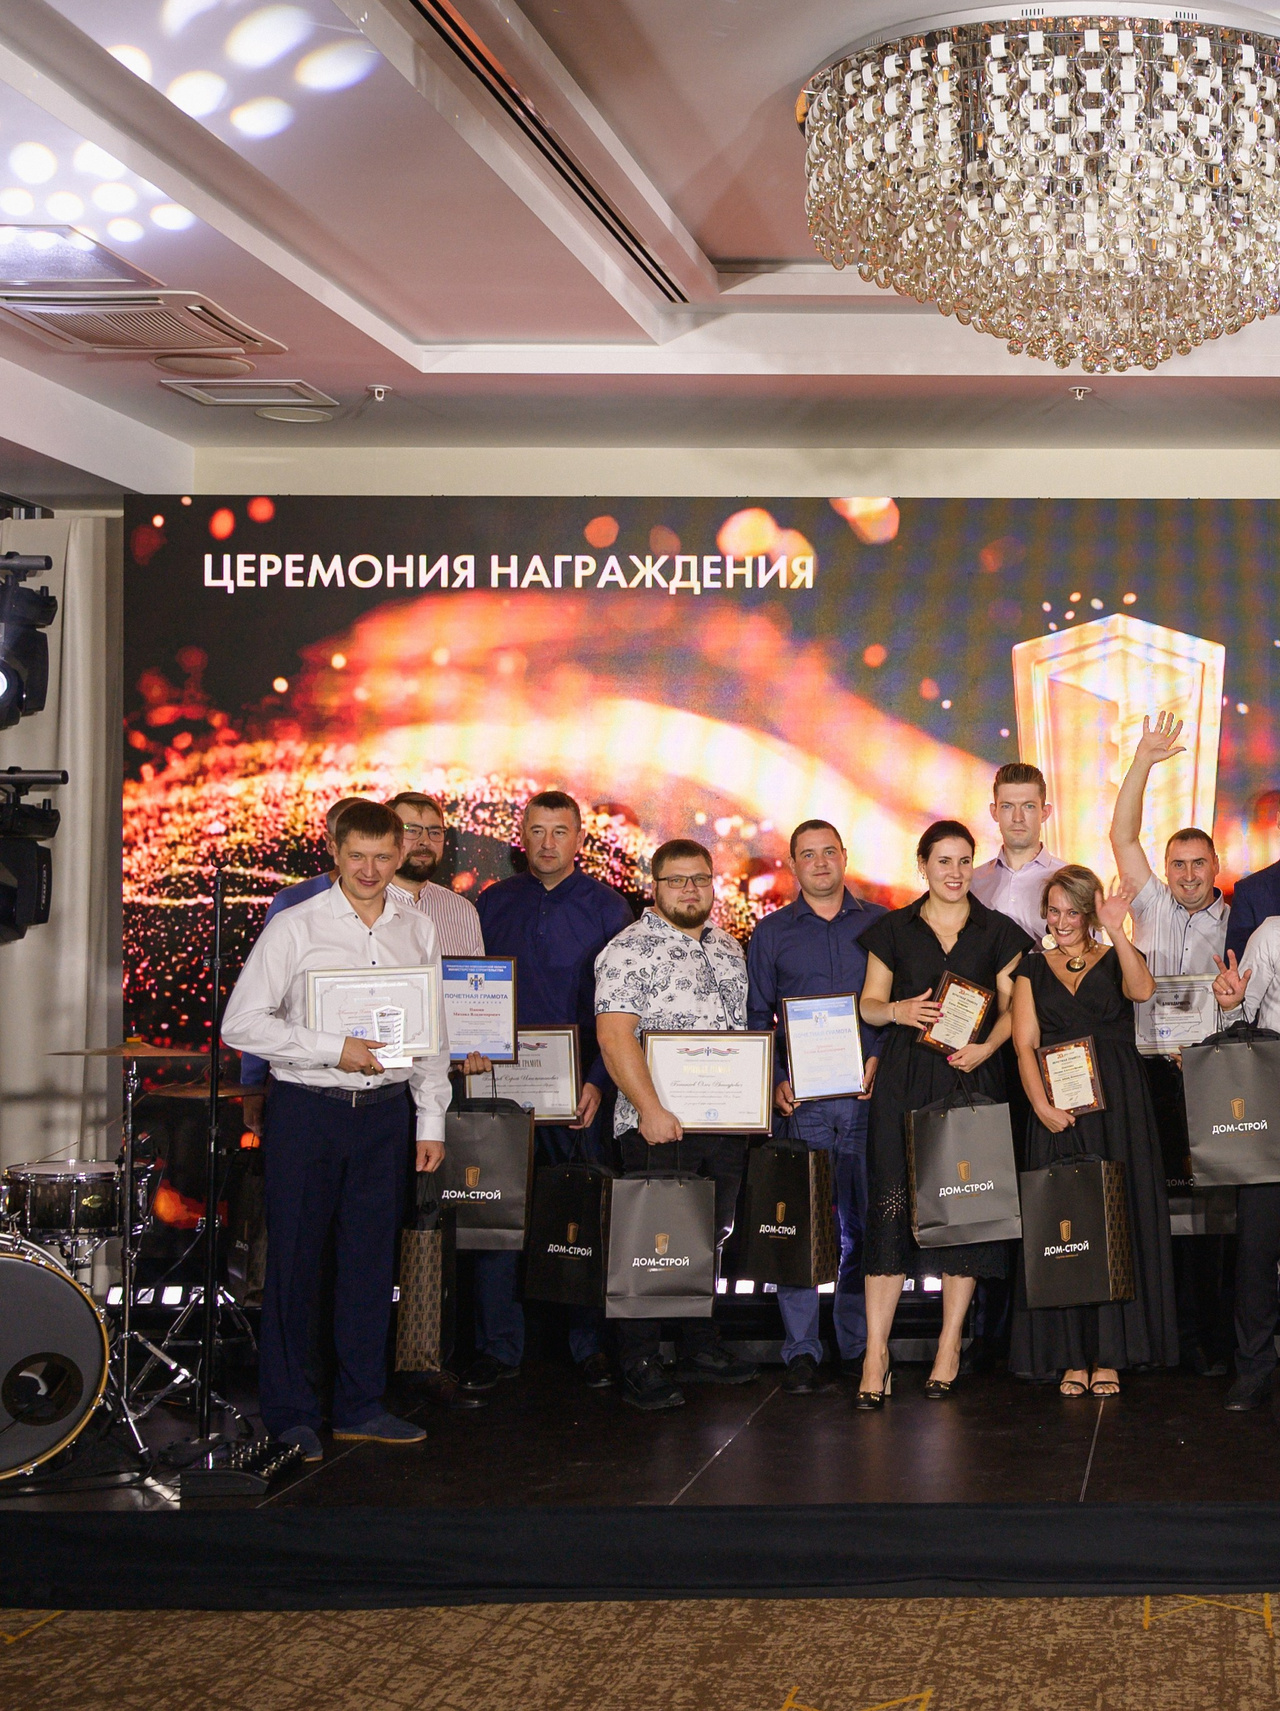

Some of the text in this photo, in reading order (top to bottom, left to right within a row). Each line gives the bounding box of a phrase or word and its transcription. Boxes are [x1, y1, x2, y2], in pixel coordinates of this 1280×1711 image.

[203, 553, 815, 595] ЦЕРЕМОНИЯ НАГРАЖДЕНИЯ
[1211, 1119, 1268, 1135] ДОМ-СТРОЙ
[938, 1180, 994, 1197] ДОМ-СТРОЙ
[1166, 1178, 1194, 1187] ДОМ-С
[441, 1189, 501, 1200] ДОМ-СТРОЙ
[759, 1224, 797, 1235] ДОМ-СТРОЙ
[547, 1243, 593, 1257] ДОМ-СТРОЙ
[1044, 1240, 1089, 1256] ДОМ-СТРОЙ
[632, 1256, 690, 1267] ДОМ-СТРОЙ
